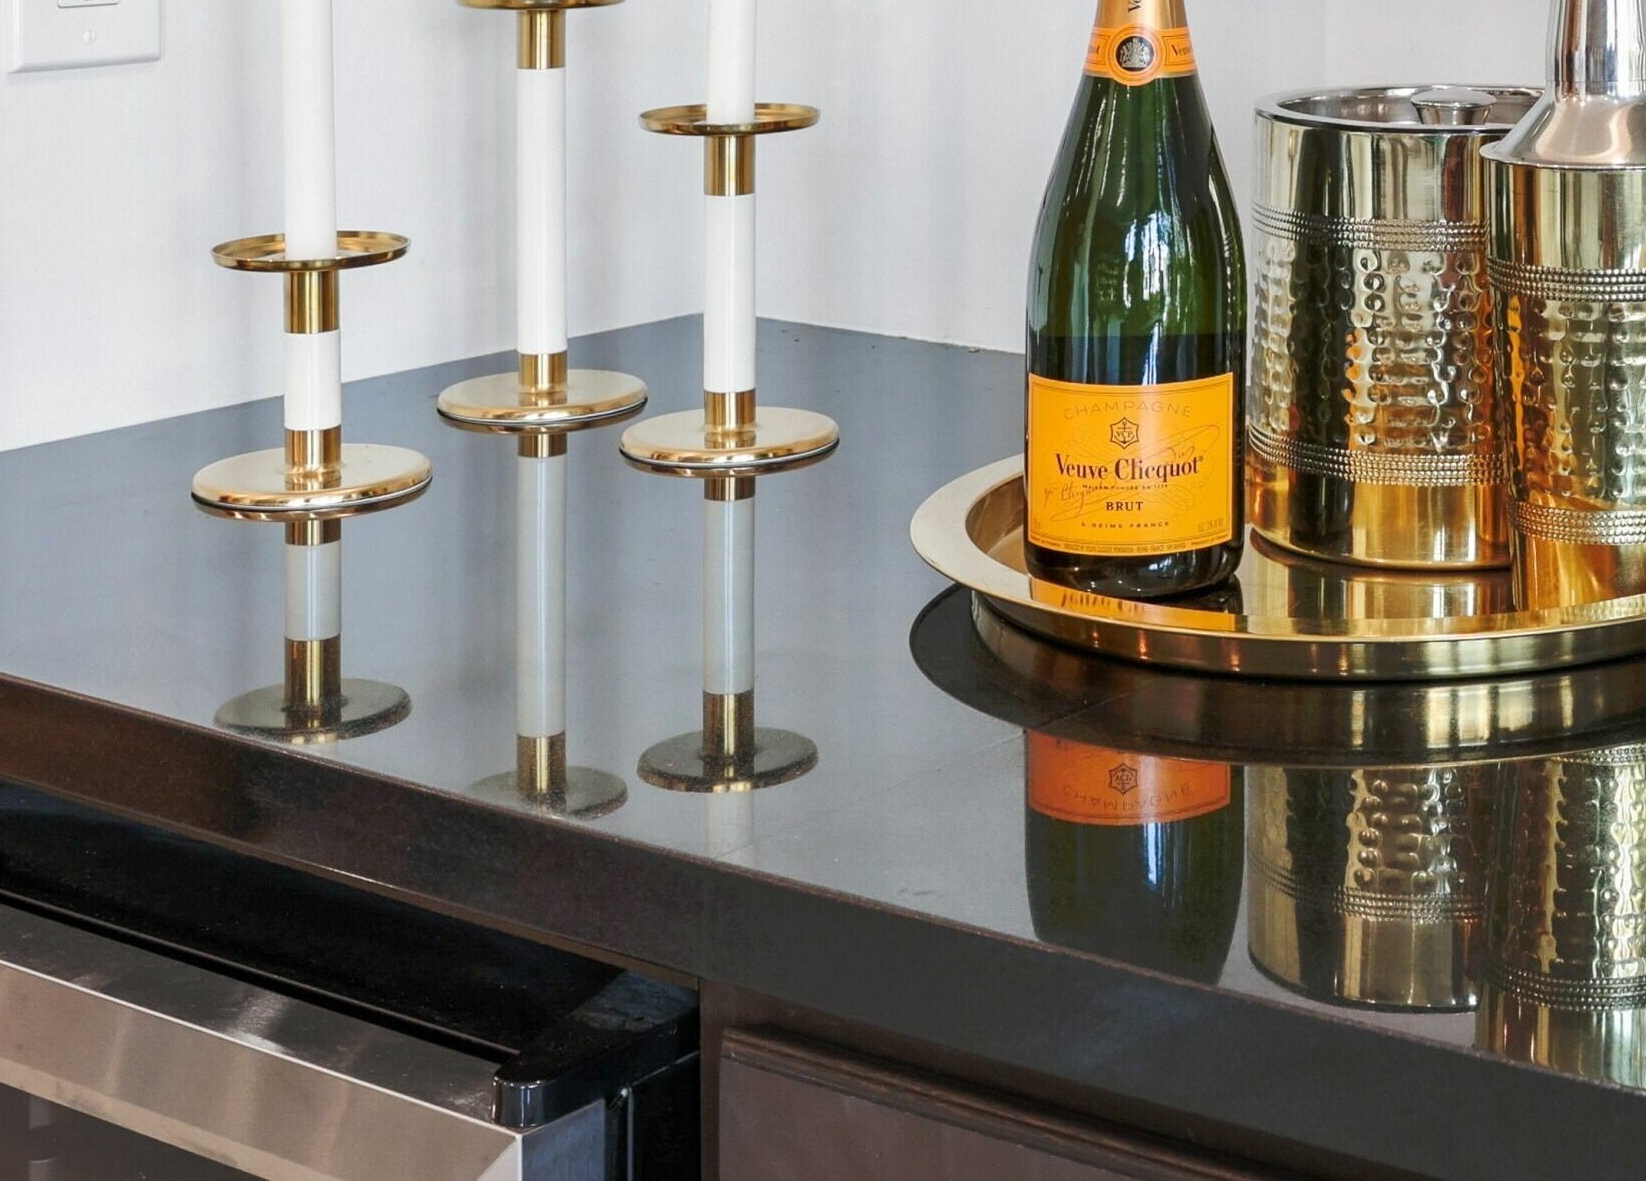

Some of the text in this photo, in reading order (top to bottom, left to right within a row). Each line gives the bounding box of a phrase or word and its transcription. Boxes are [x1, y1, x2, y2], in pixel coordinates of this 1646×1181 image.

[1063, 401, 1192, 419] CHAMPAGNE
[1055, 453, 1108, 479] Veuve
[1105, 501, 1144, 512] BRUT
